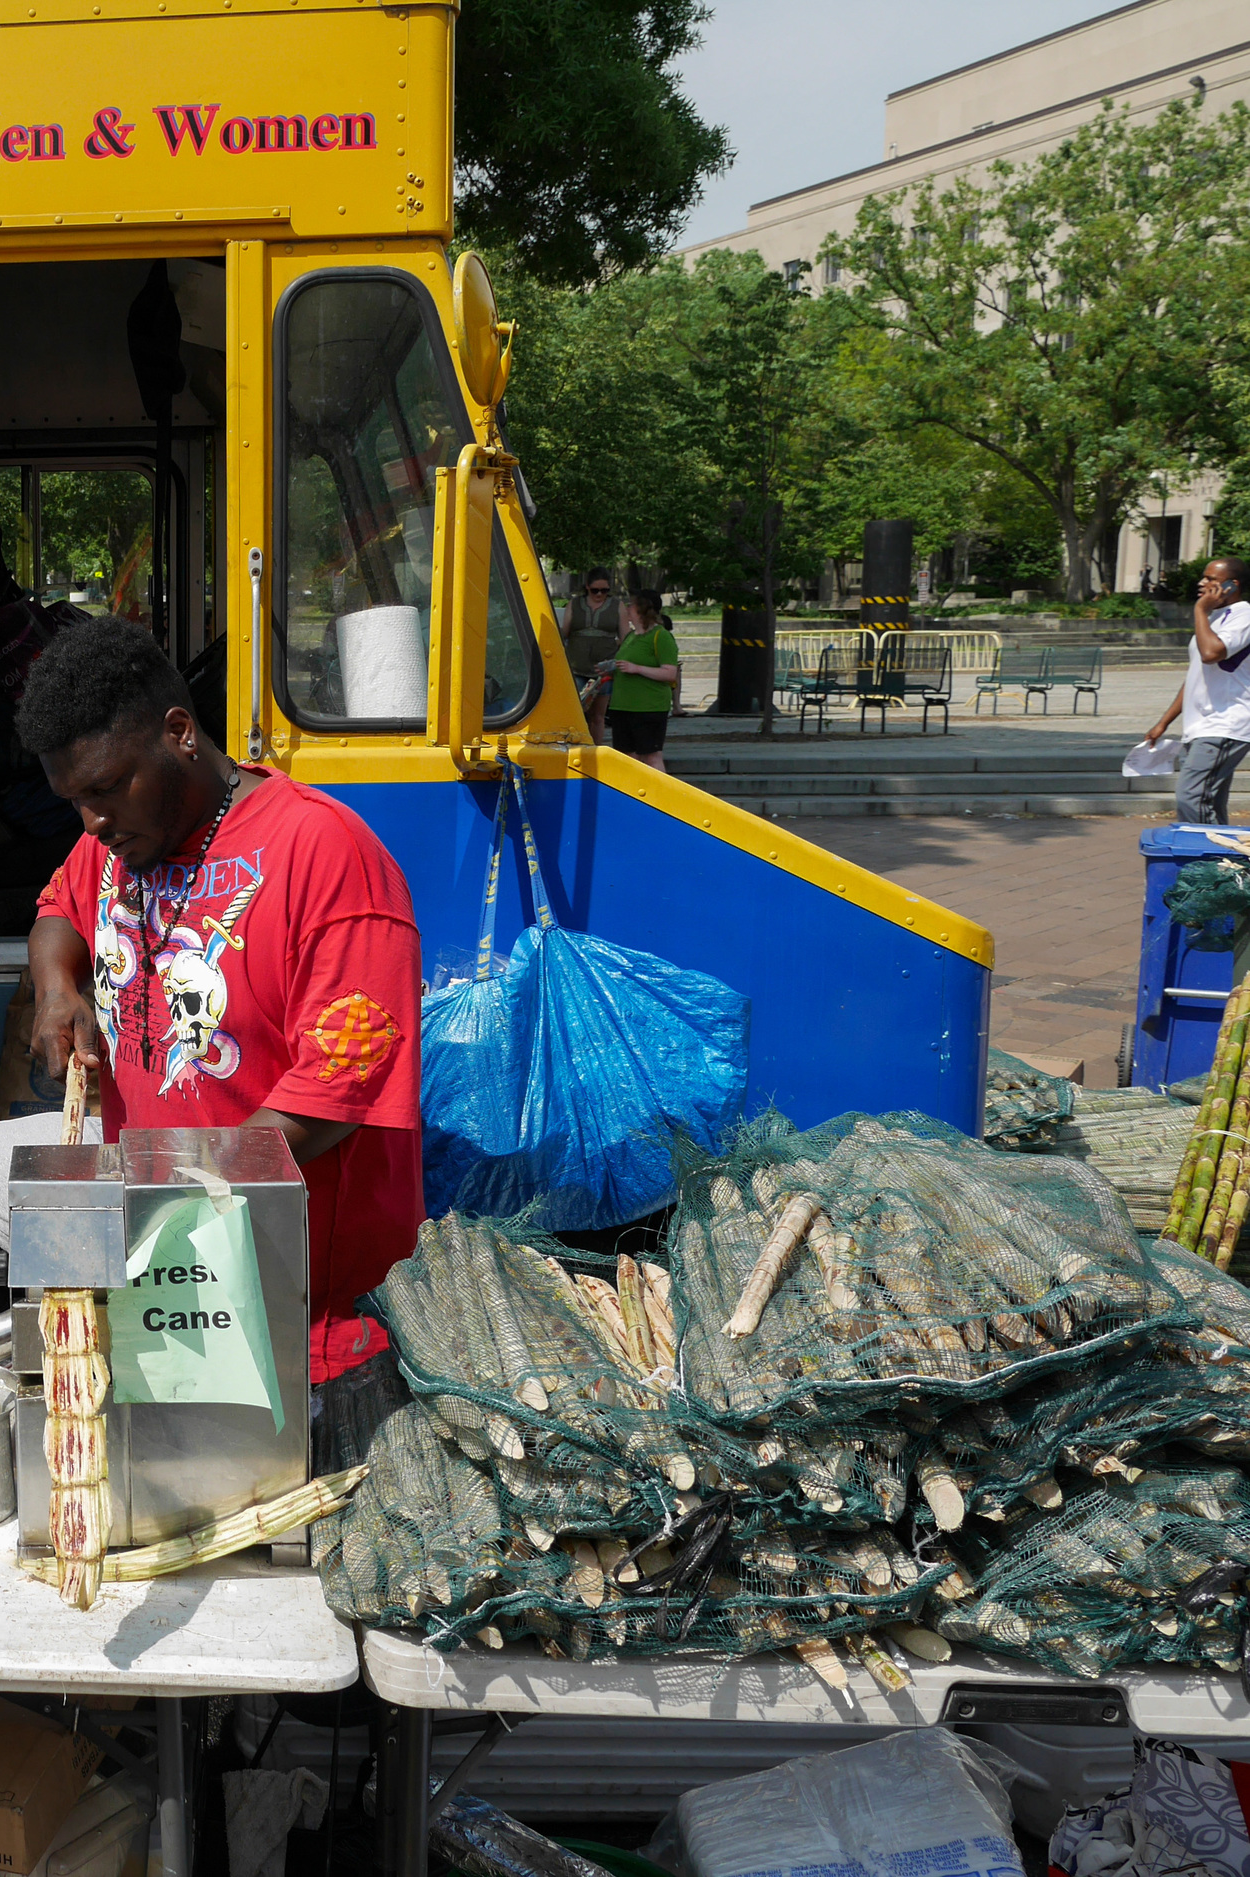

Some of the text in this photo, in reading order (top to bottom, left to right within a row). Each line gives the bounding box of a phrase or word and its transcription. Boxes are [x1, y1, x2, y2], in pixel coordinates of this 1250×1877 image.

[83, 106, 136, 159] &
[152, 104, 378, 157] Women
[521, 822, 539, 876] IKEA
[485, 851, 500, 904] IKEA
[142, 1307, 232, 1332] Cane
